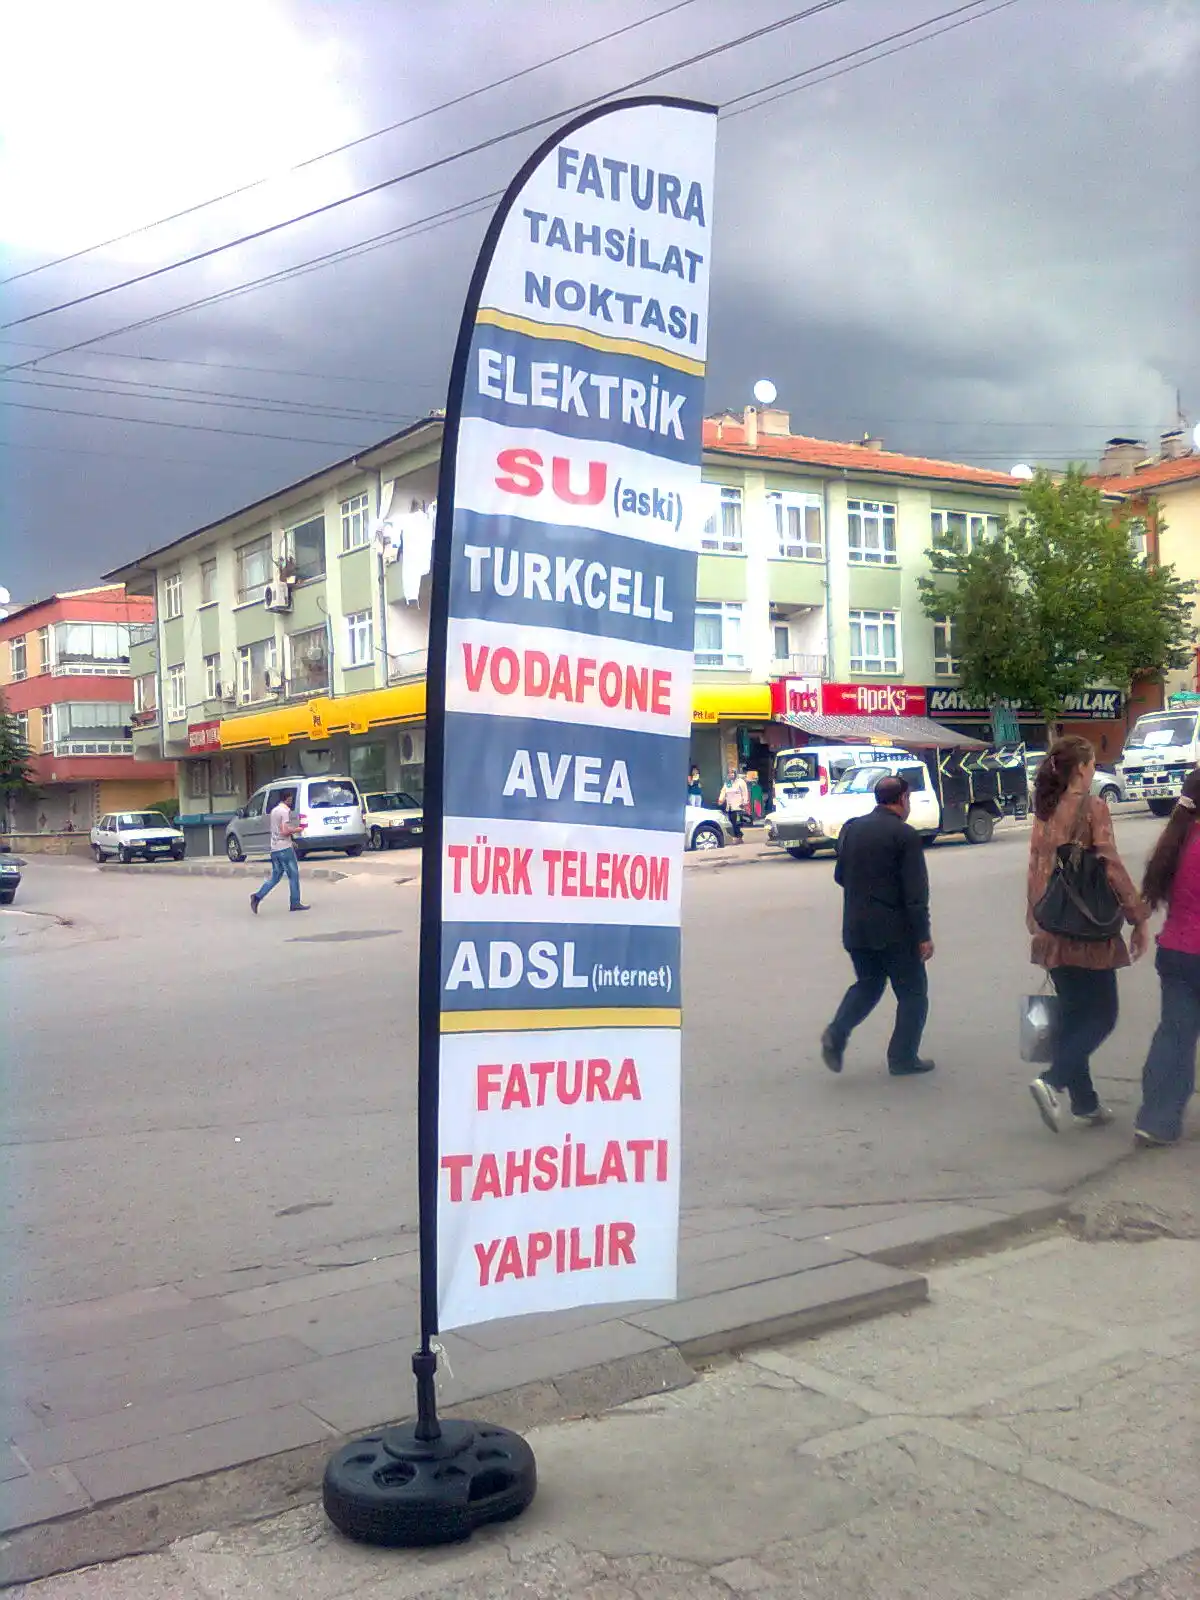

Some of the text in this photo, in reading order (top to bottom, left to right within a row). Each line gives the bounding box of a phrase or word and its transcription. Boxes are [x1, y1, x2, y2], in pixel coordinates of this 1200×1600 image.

[557, 147, 706, 227] FATURA
[523, 209, 704, 283] TAHSİLAT
[525, 271, 699, 344] NOKTASI
[477, 349, 686, 440] ELEKTRİK
[494, 448, 682, 532] SU (aski)
[464, 544, 673, 622] TURKCELL
[463, 642, 671, 715] VODAFONE
[858, 686, 906, 715] Apeks
[503, 750, 634, 806] AVEA
[448, 836, 669, 900] TÜRK TELEKOM
[444, 941, 672, 992] ADSL (internet)
[477, 1058, 641, 1111] FATURA
[441, 1133, 668, 1201] TAHSİLATI
[474, 1222, 636, 1286] YAPILIR
